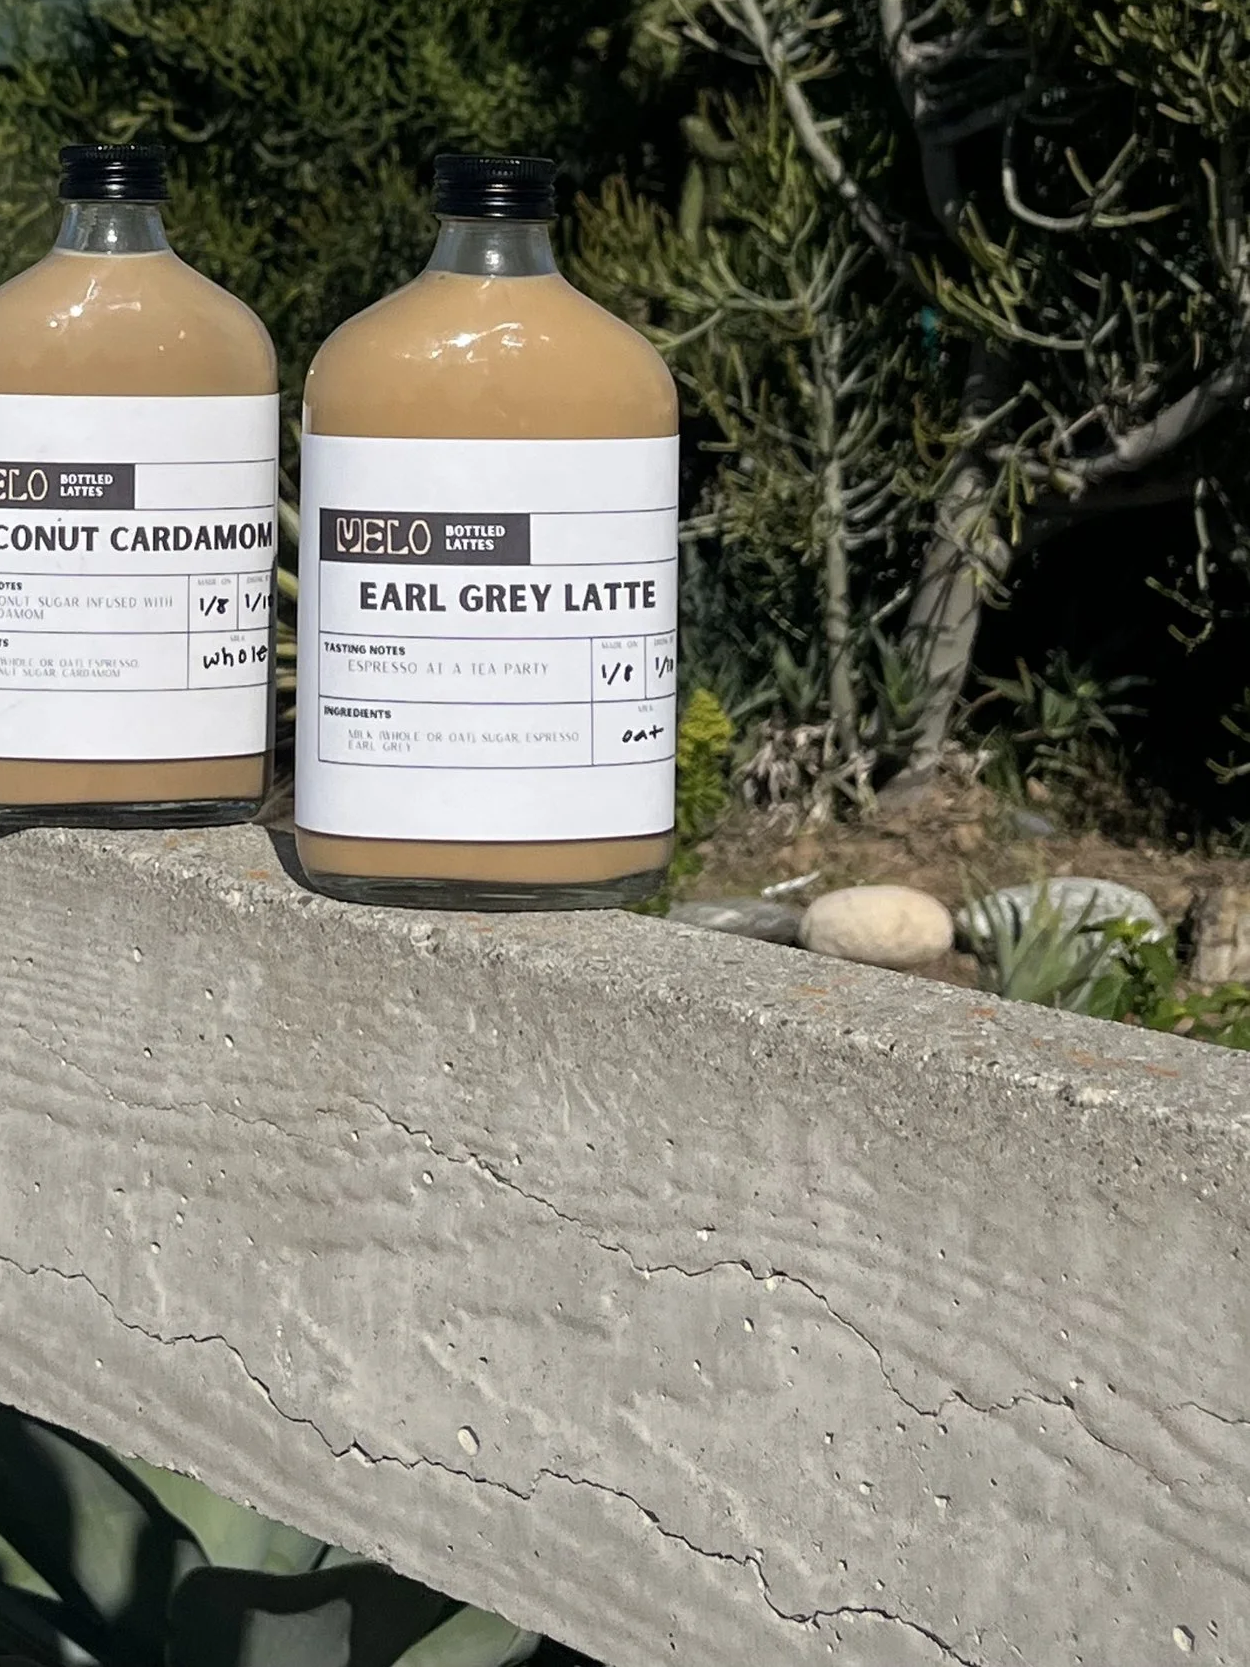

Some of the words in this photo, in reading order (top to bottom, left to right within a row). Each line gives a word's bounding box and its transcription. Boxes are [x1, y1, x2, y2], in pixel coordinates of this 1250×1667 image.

[60, 474, 113, 485] BOTTLED
[60, 486, 103, 497] LATTES
[111, 521, 272, 551] CARDAMOM
[445, 525, 505, 537] BOTTLED
[446, 539, 494, 551] LATTES
[38, 597, 79, 608] SUGAR
[87, 597, 136, 608] INFUSED
[144, 596, 173, 608] WITH
[360, 582, 446, 612] EARL
[459, 584, 551, 612] GREY
[565, 580, 656, 612] LATTE
[200, 596, 229, 616] 1/8
[324, 642, 366, 654] TASTING
[370, 645, 405, 656] NOTES
[40, 658, 53, 668] OR
[203, 645, 268, 669] whole
[348, 659, 417, 674] ESPRESSO
[426, 662, 443, 674] AT
[452, 662, 462, 675] A
[471, 662, 497, 675] TEA
[505, 663, 549, 675] PARTY
[324, 706, 391, 719] INGREDIENTS
[427, 733, 442, 742] OR
[622, 725, 664, 743] oat
[348, 740, 376, 751] EARL
[383, 742, 410, 752] GREY
